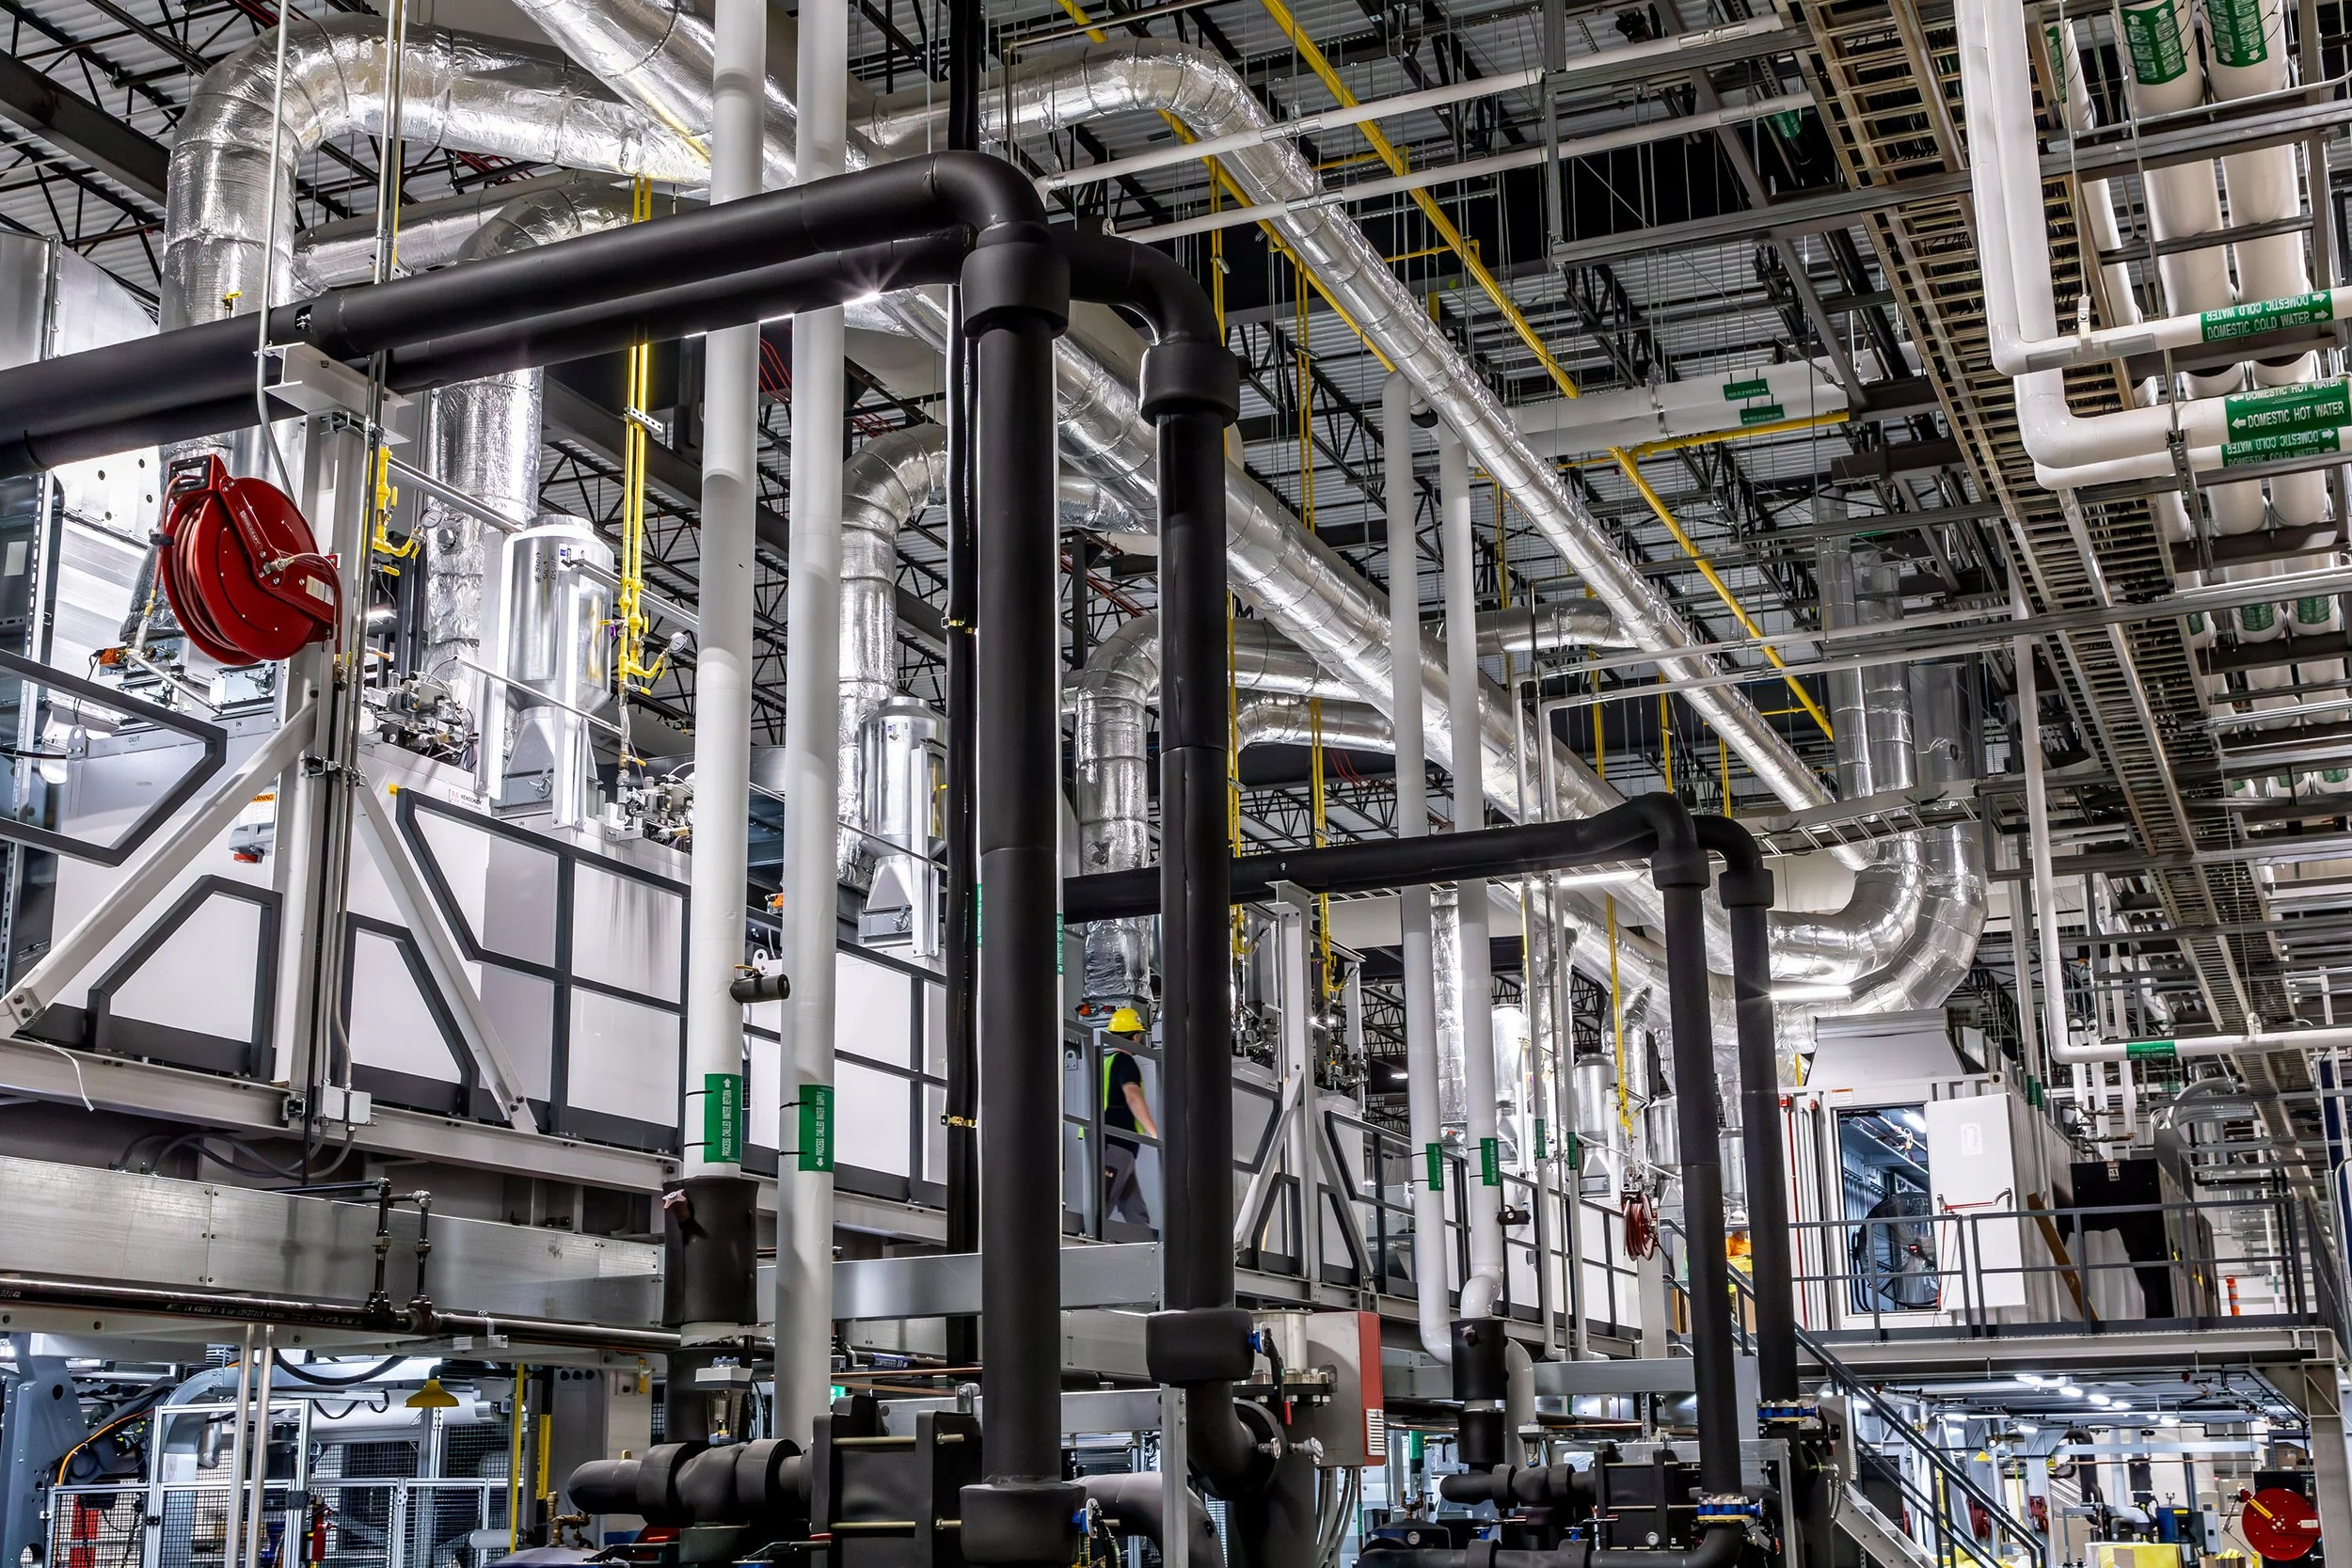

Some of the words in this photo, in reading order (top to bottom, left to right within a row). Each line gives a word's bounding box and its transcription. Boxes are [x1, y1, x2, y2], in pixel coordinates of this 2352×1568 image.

[2238, 304, 2262, 317] COLD
[2265, 294, 2309, 312] DOMESTIC
[2206, 308, 2235, 322] WATER
[2207, 321, 2250, 340] DOMESTIC
[2253, 316, 2277, 332] COLD
[2280, 311, 2311, 326] WATER
[2245, 387, 2287, 402] DOMESTIC
[2291, 384, 2309, 393] HOT
[2312, 378, 2342, 390] WATER
[2247, 409, 2290, 429] DOMESTIC
[2293, 405, 2311, 421] HOT
[2314, 401, 2344, 418] WATER
[2226, 440, 2253, 454] WATER
[2255, 436, 2277, 451] COLD
[2280, 430, 2319, 448] DOMESTIC
[722, 1106, 732, 1120] WATER
[816, 1107, 825, 1120] WATER
[722, 1120, 732, 1137] CHILLED
[816, 1120, 825, 1137] CHILLED
[722, 1137, 732, 1157] PROCESS
[816, 1138, 825, 1157] PROCESS
